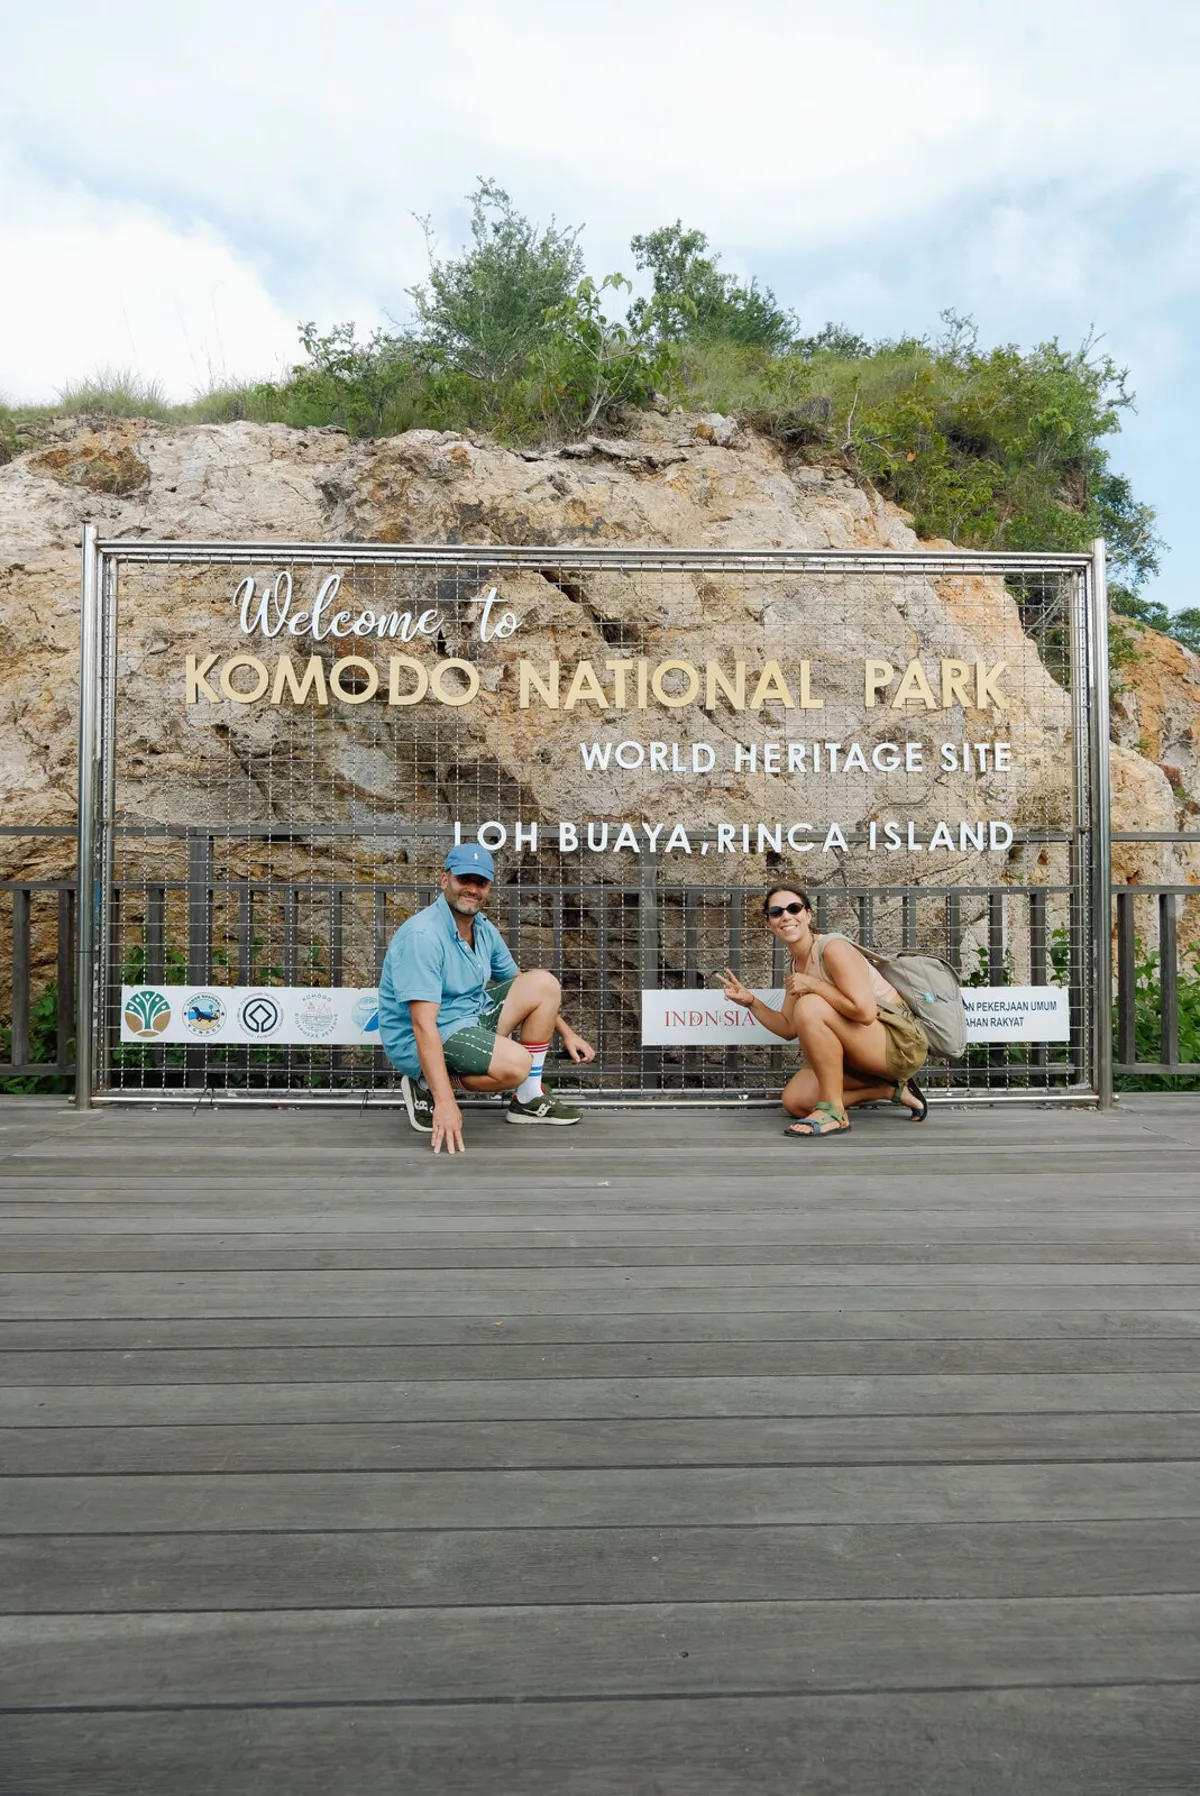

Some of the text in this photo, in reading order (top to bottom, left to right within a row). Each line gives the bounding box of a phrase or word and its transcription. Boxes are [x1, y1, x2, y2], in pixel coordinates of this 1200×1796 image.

[232, 571, 523, 643] Welcome to
[185, 653, 1010, 710] KOMODO NATIONAL PARK
[580, 740, 1012, 773] WORLD HERITAGE SITE
[869, 821, 1014, 852] ISLAND
[976, 1001, 1029, 1012] PEKERJAAN
[1030, 1001, 1057, 1011] UMUM
[990, 1017, 1025, 1027] RAKYAT
